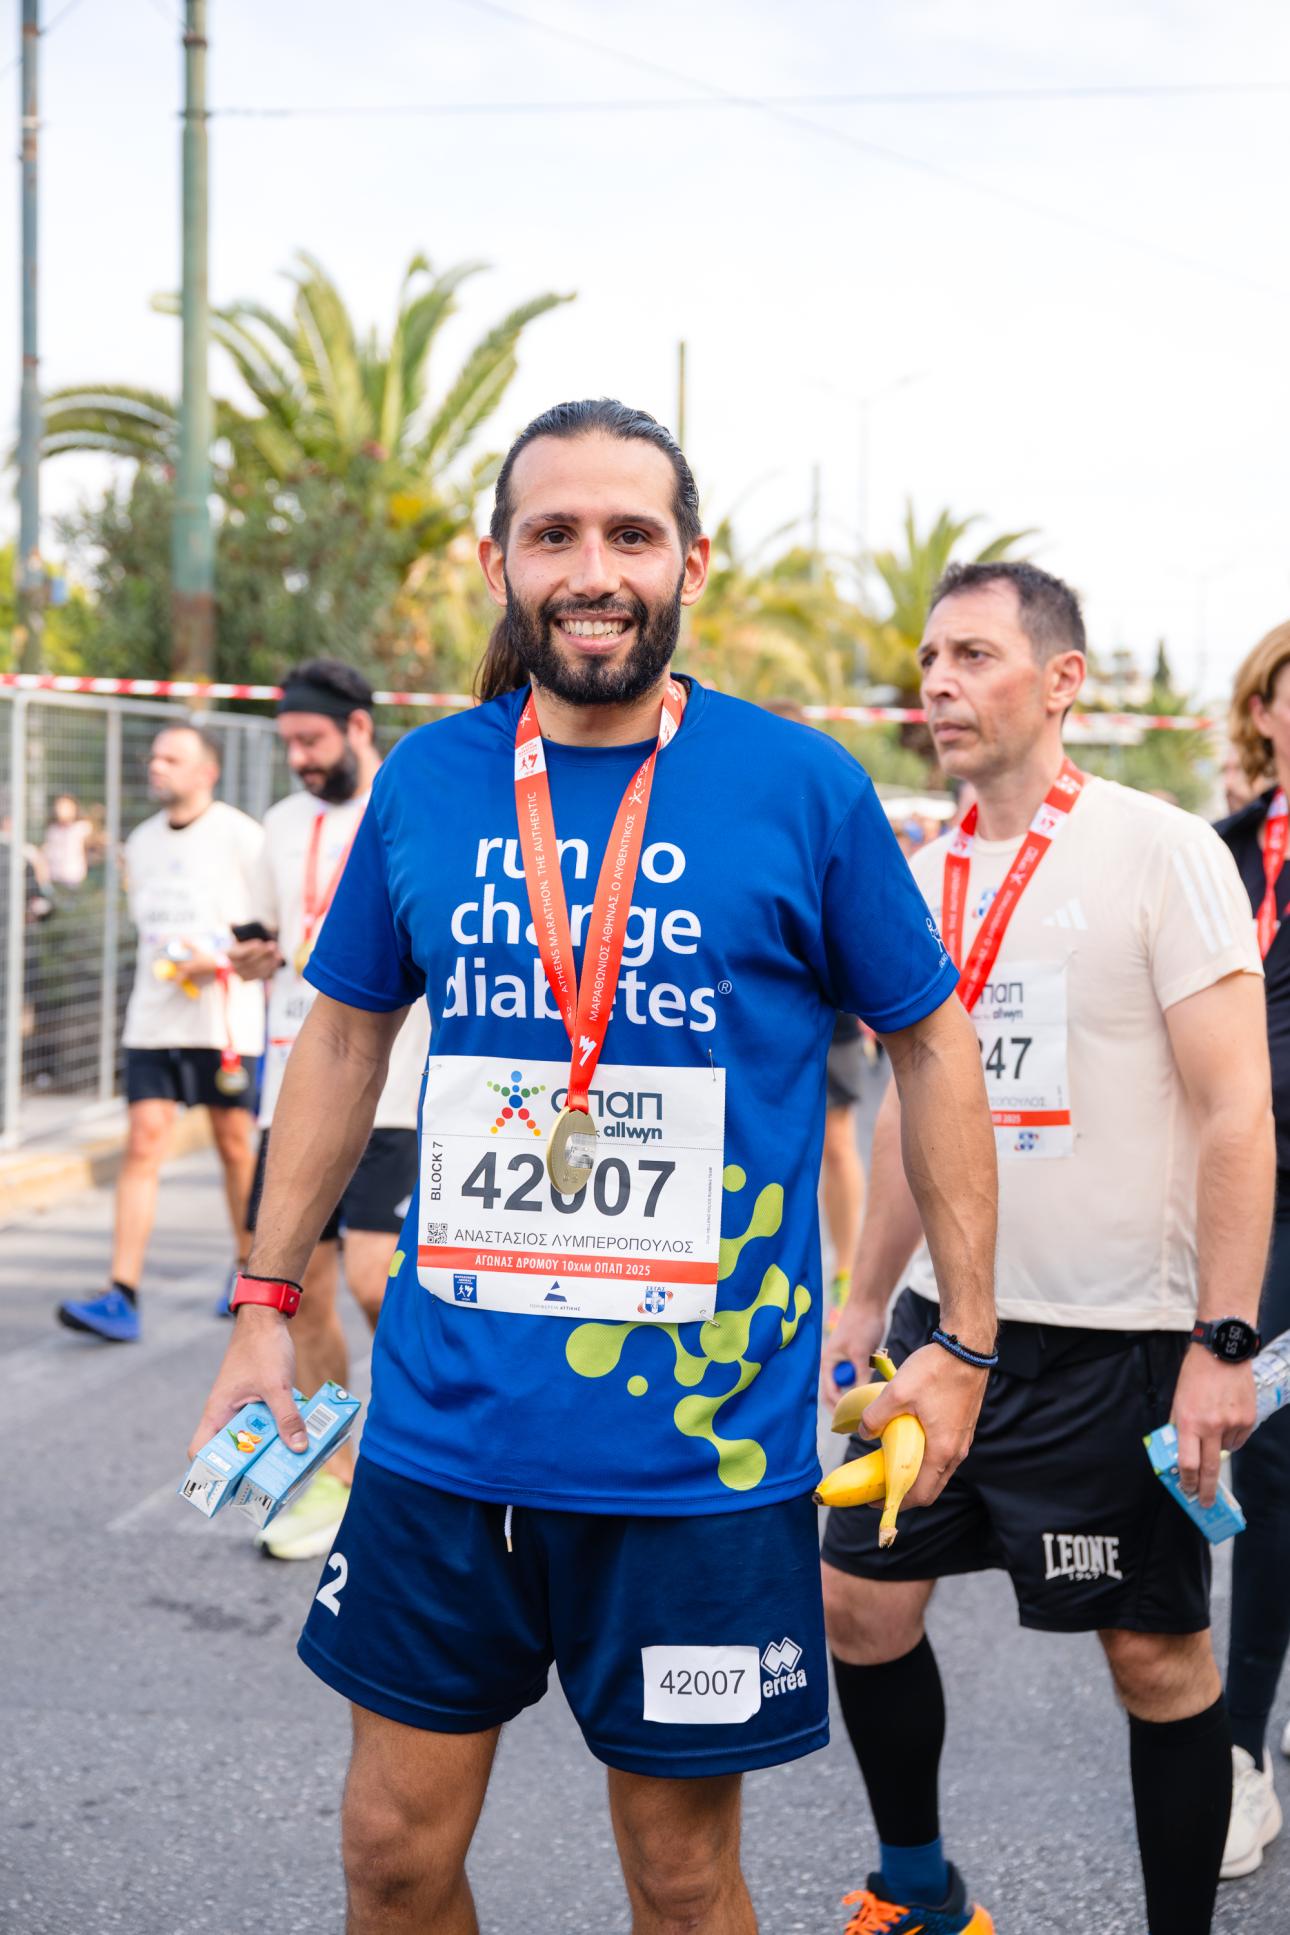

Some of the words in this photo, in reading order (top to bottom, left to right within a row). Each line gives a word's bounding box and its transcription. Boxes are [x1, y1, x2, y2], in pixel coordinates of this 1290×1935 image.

[527, 791, 544, 852] AUTHENTIC
[535, 855, 547, 877] THE
[636, 841, 686, 884] o
[450, 883, 702, 967] chnge
[588, 944, 611, 1022] ΜΑΡΑΘΩΝΙΟΣ
[613, 813, 636, 880] ΑΥΘΕΝΤΙΚΟΣ
[549, 950, 569, 993] ATHENS
[978, 1036, 1033, 1080] 47
[432, 1141, 444, 1149] 7
[603, 1121, 663, 1144] allwyn
[430, 1153, 443, 1201] BLOCK
[454, 1228, 549, 1246] ΑΝΑΣΤΑΣΙΟΣ
[551, 1234, 694, 1254] ΛΥΜΠΕΡΟΠΟΥΛΟΣ
[475, 1254, 514, 1268] ΑΓΩΝΑΣ
[515, 1257, 559, 1271] ΔΡΟΜΟΥ
[594, 1262, 623, 1275] ΟΠΑΠ
[625, 1264, 651, 1276] 2025
[1042, 1533, 1122, 1580] LEONE
[316, 1552, 349, 1616] 2
[659, 1669, 746, 1696] 42007
